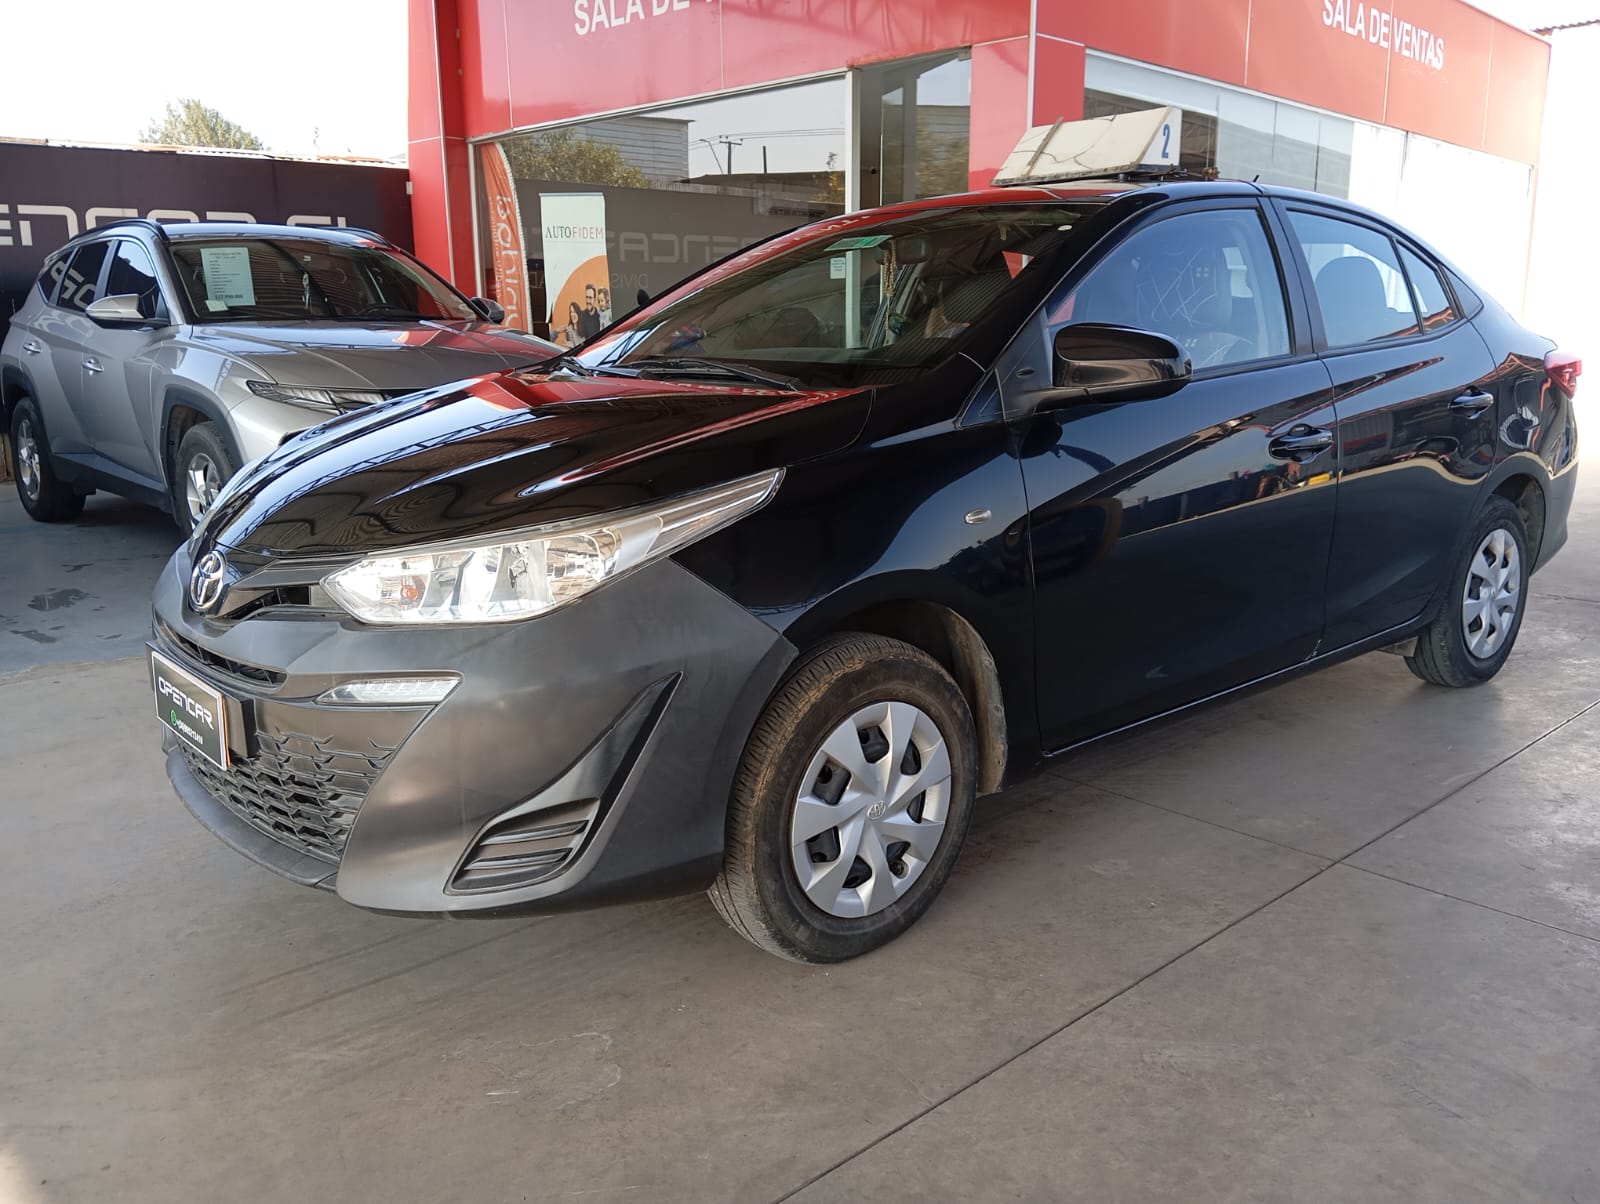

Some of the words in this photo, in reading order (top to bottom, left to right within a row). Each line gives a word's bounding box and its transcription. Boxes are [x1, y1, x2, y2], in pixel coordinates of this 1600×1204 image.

[574, 0, 645, 35] SALA
[1322, 0, 1366, 39] SALA
[1368, 8, 1392, 48] DE
[1393, 17, 1444, 70] VENTAS
[1161, 123, 1171, 159] 2
[545, 225, 604, 240] AUTOFIDEM
[158, 675, 214, 730] OPENCAR
